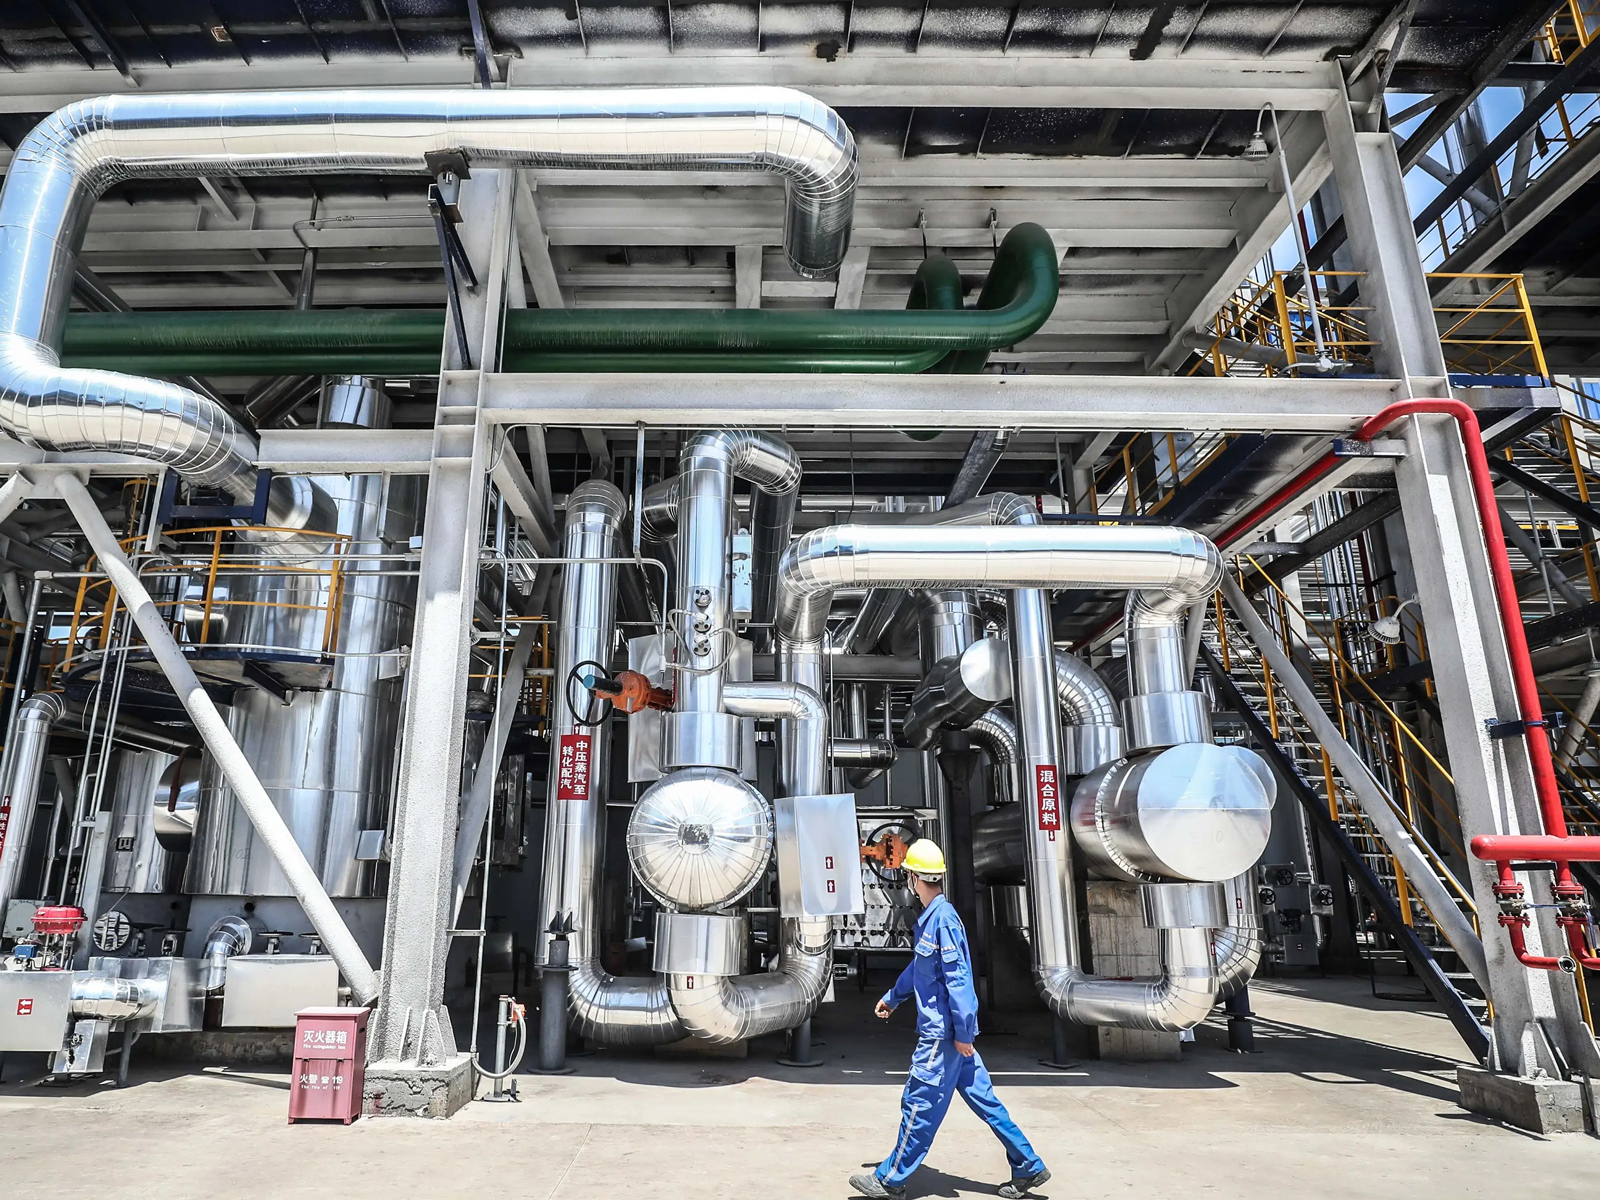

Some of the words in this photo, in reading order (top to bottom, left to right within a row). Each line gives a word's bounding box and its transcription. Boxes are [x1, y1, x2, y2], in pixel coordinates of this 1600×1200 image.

[560, 745, 574, 789] 转化配汽
[573, 740, 588, 795] 中压蒸汽至
[1040, 770, 1057, 826] 混合原料
[303, 1030, 348, 1044] 灭火器箱
[299, 1074, 318, 1084] 火警
[332, 1075, 344, 1084] 119
